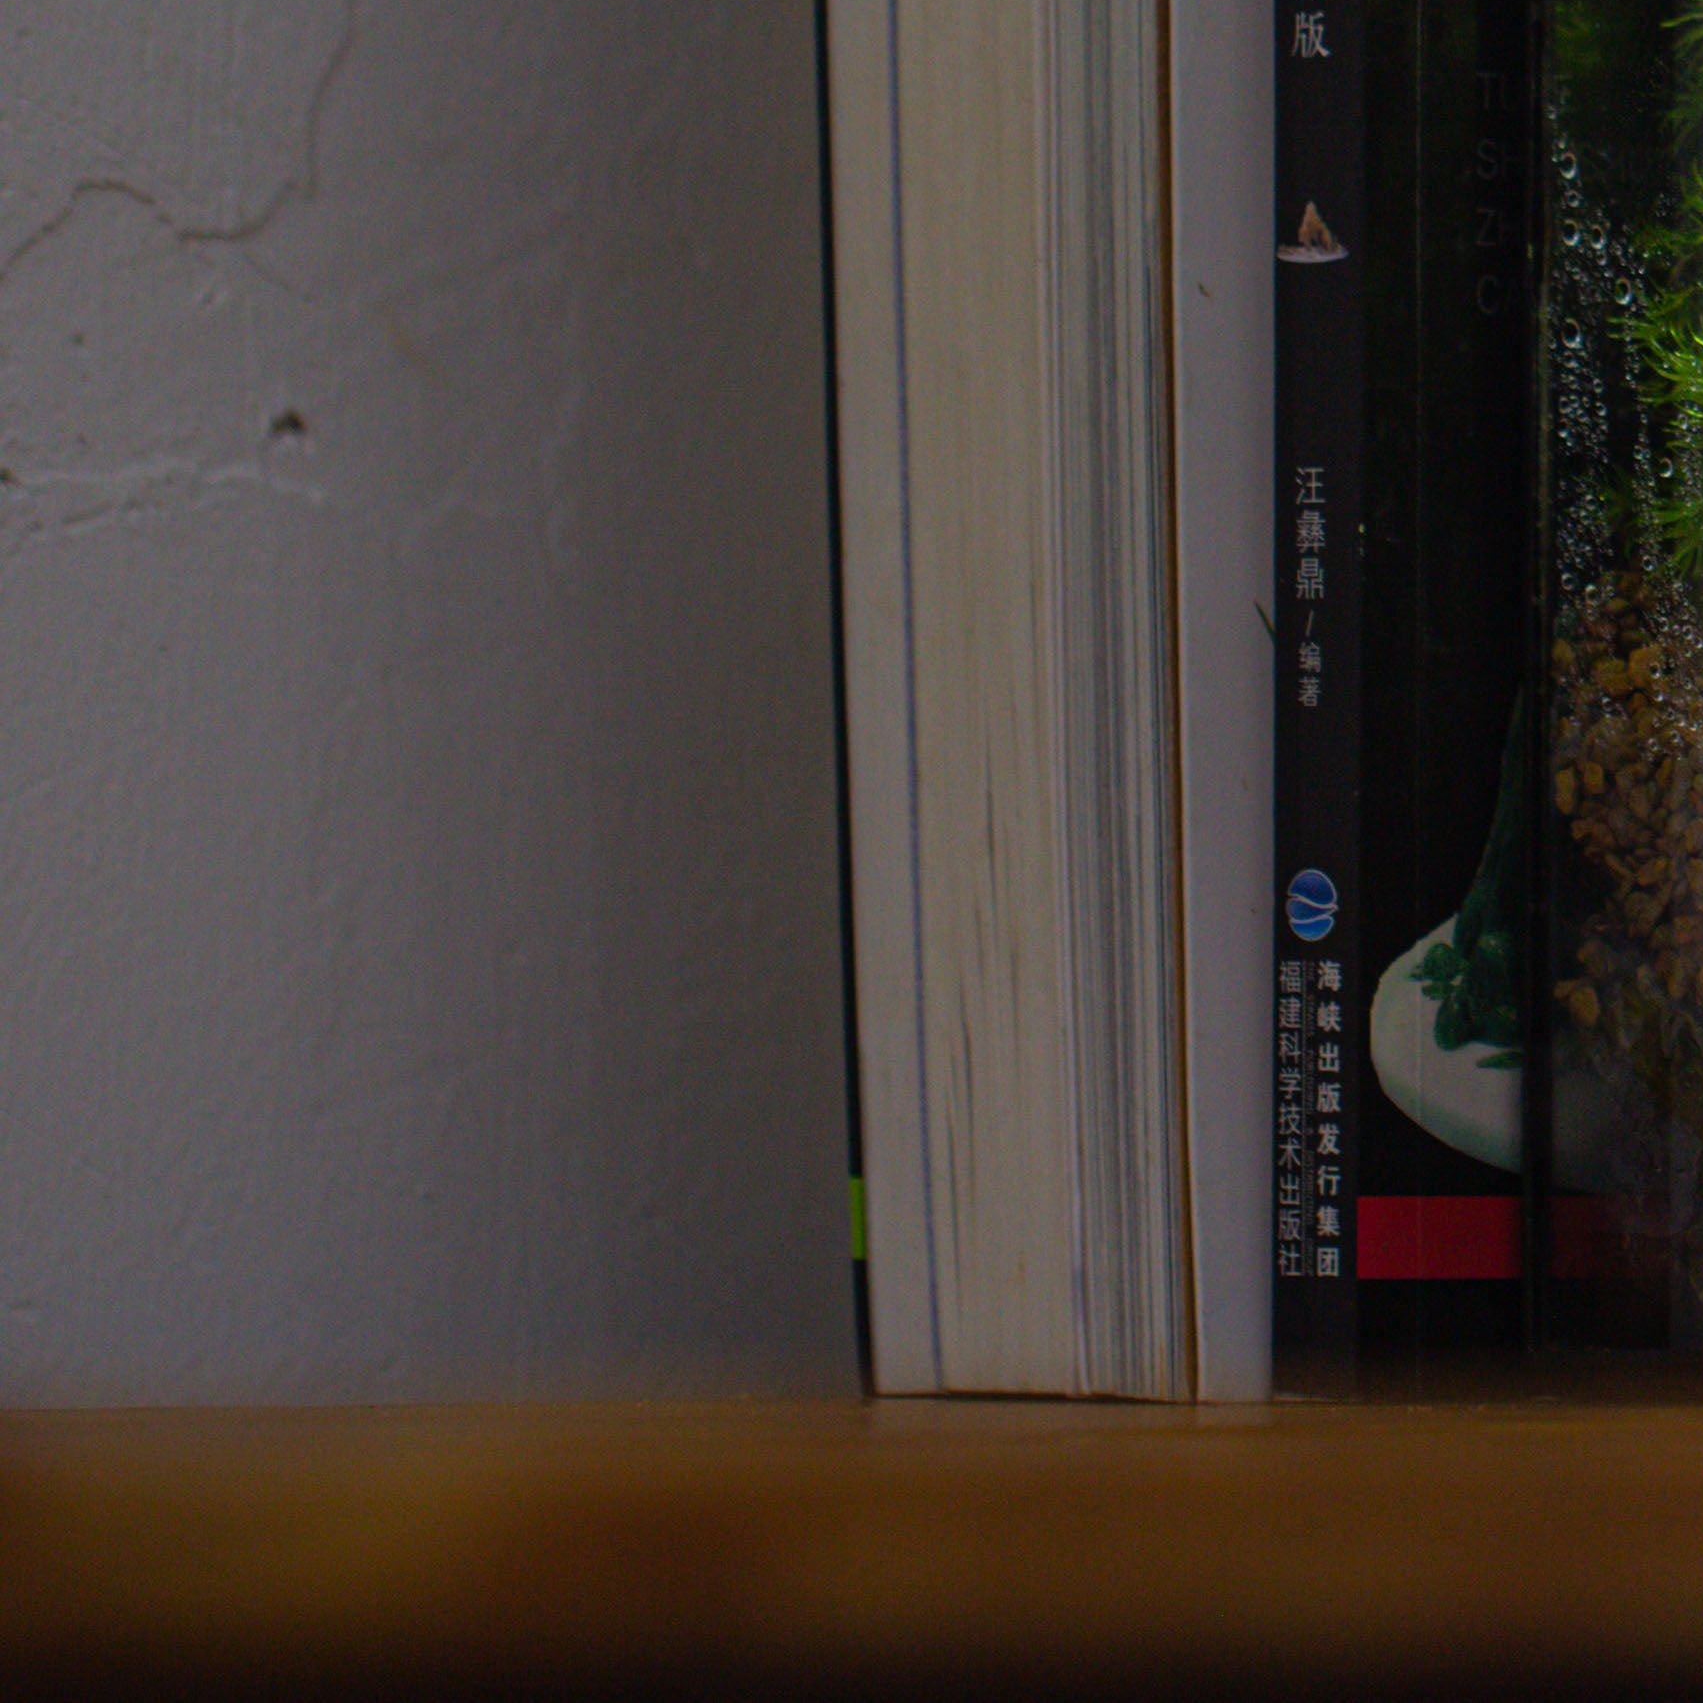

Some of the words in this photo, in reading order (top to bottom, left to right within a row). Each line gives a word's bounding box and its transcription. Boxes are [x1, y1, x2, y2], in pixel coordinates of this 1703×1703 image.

[1278, 960, 1302, 1277] 福建科学技术出版社
[1316, 960, 1342, 1277] 海峡出版发行集团
